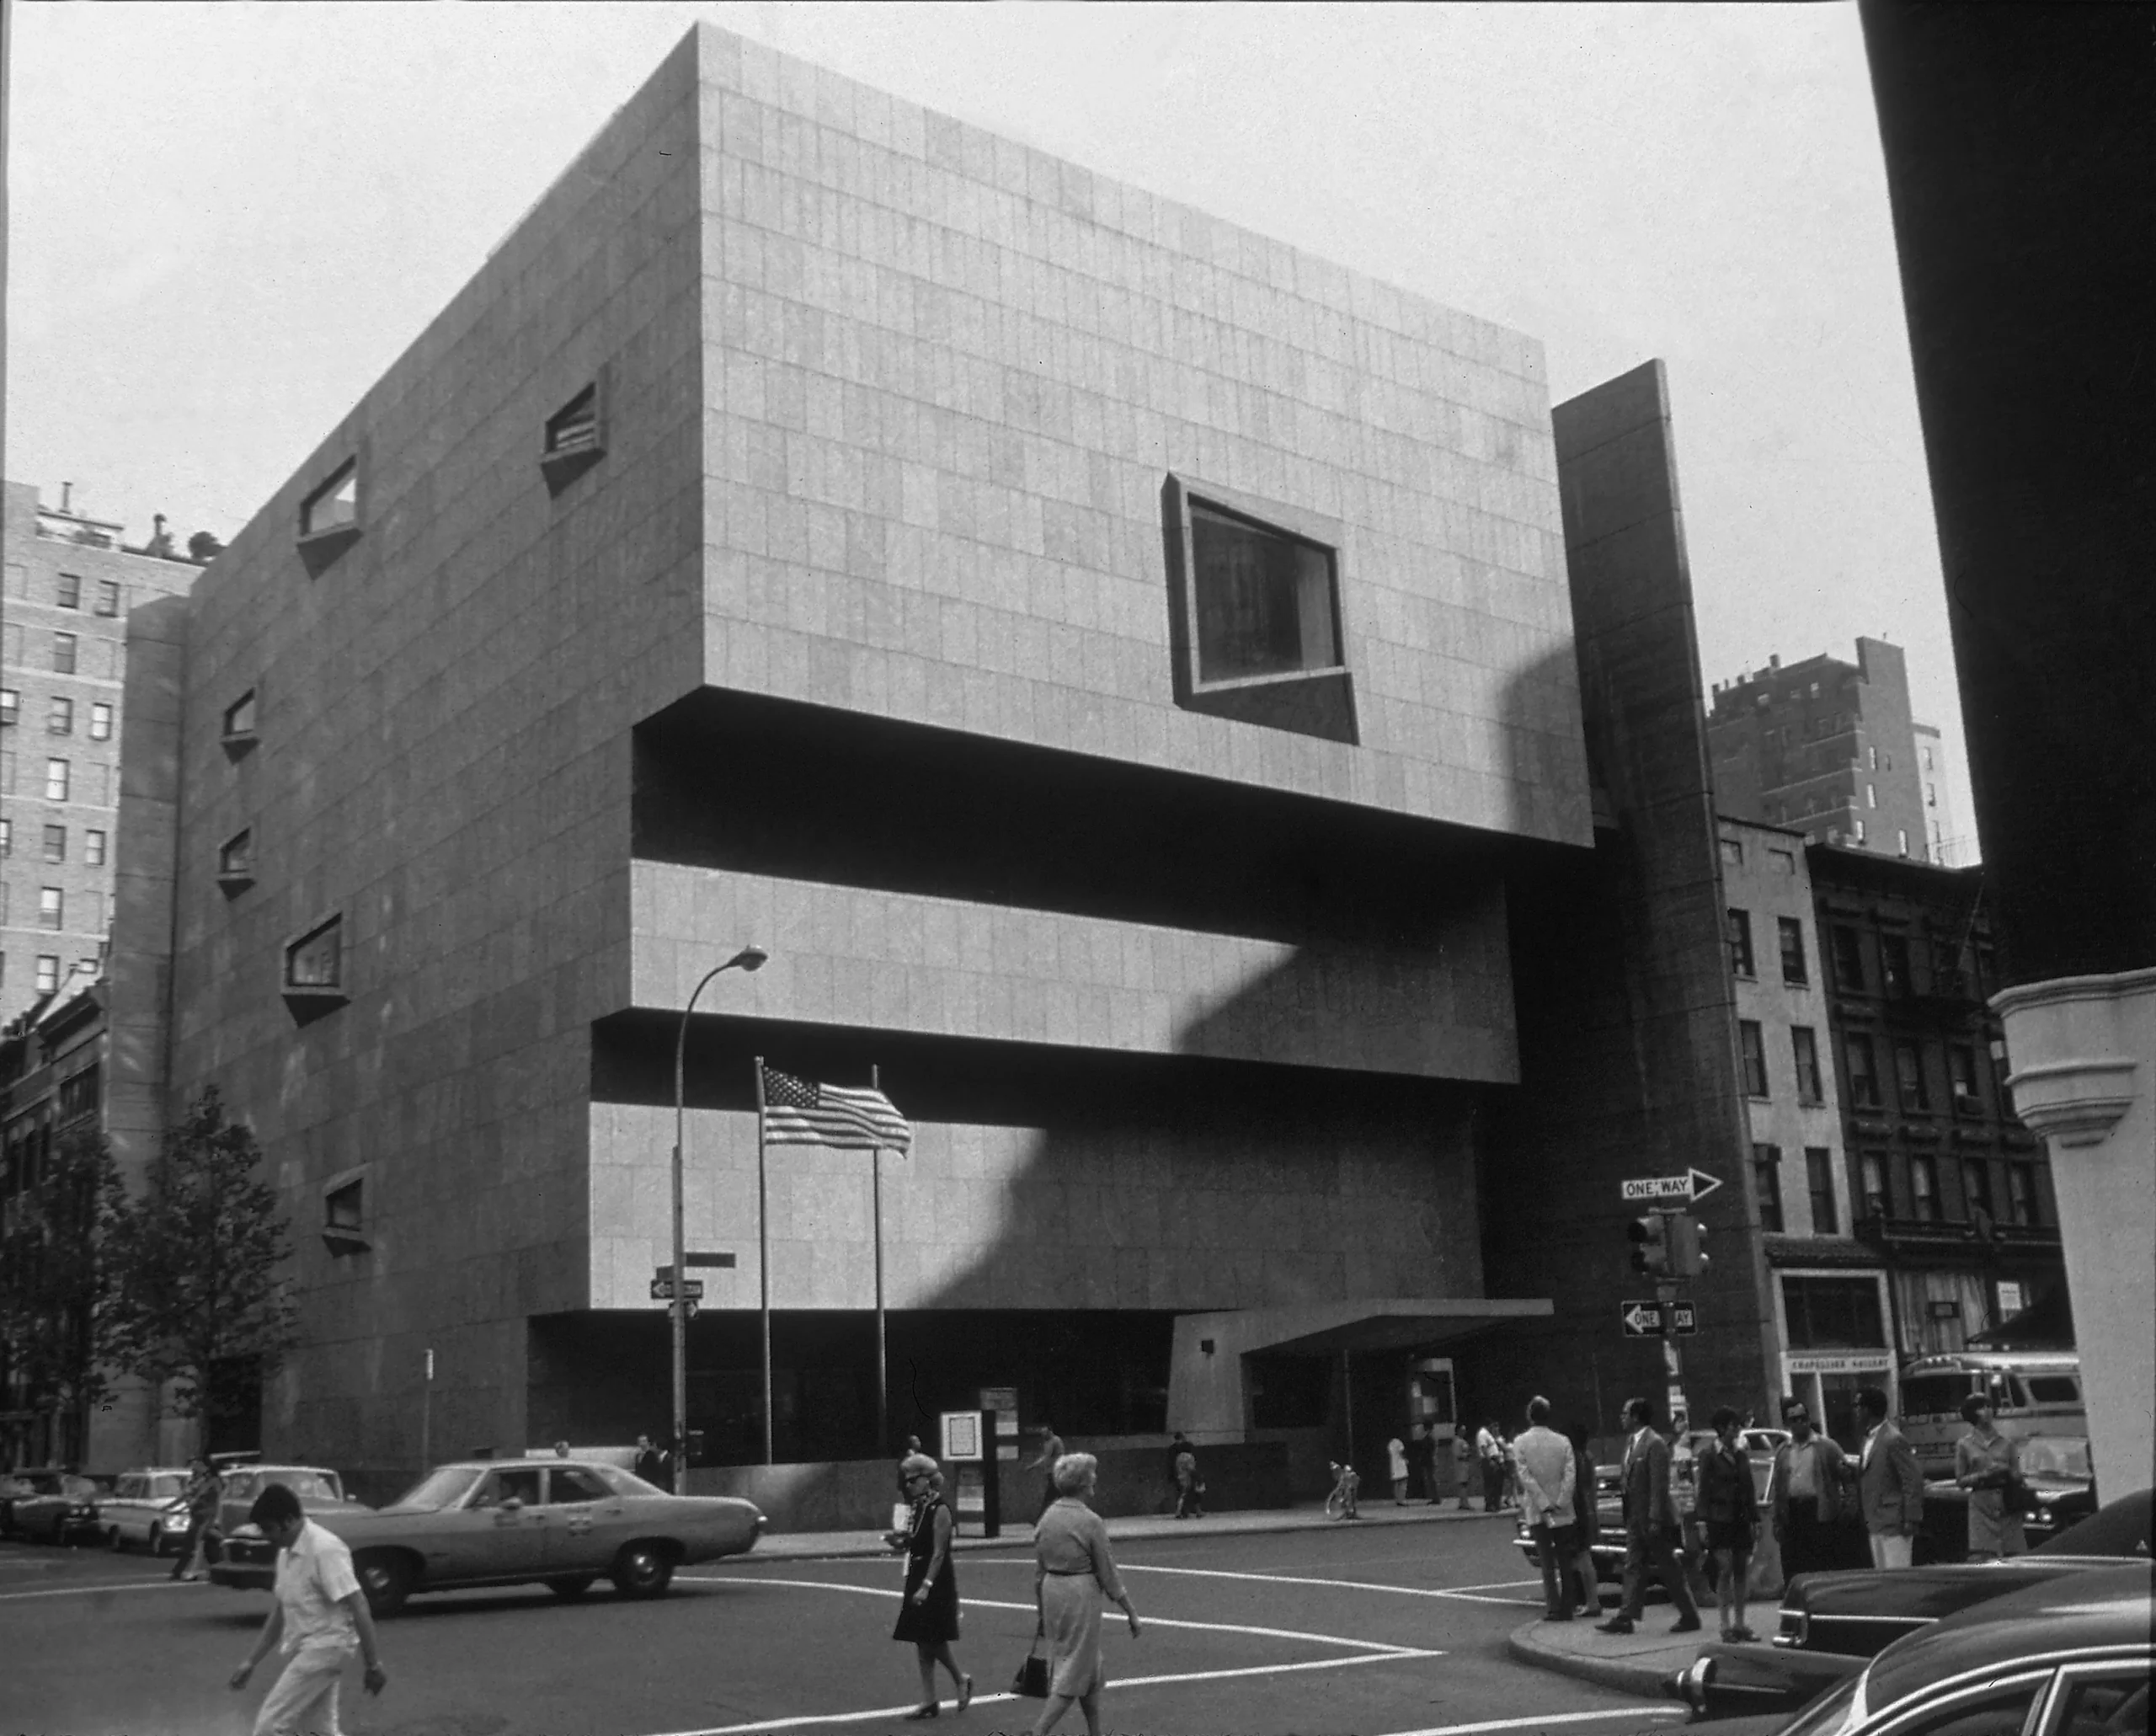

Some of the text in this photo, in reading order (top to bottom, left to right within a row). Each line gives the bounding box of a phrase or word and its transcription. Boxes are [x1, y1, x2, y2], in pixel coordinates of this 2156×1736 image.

[1627, 1178, 1688, 1196] ONE WAY
[1635, 1312, 1656, 1326] ONE
